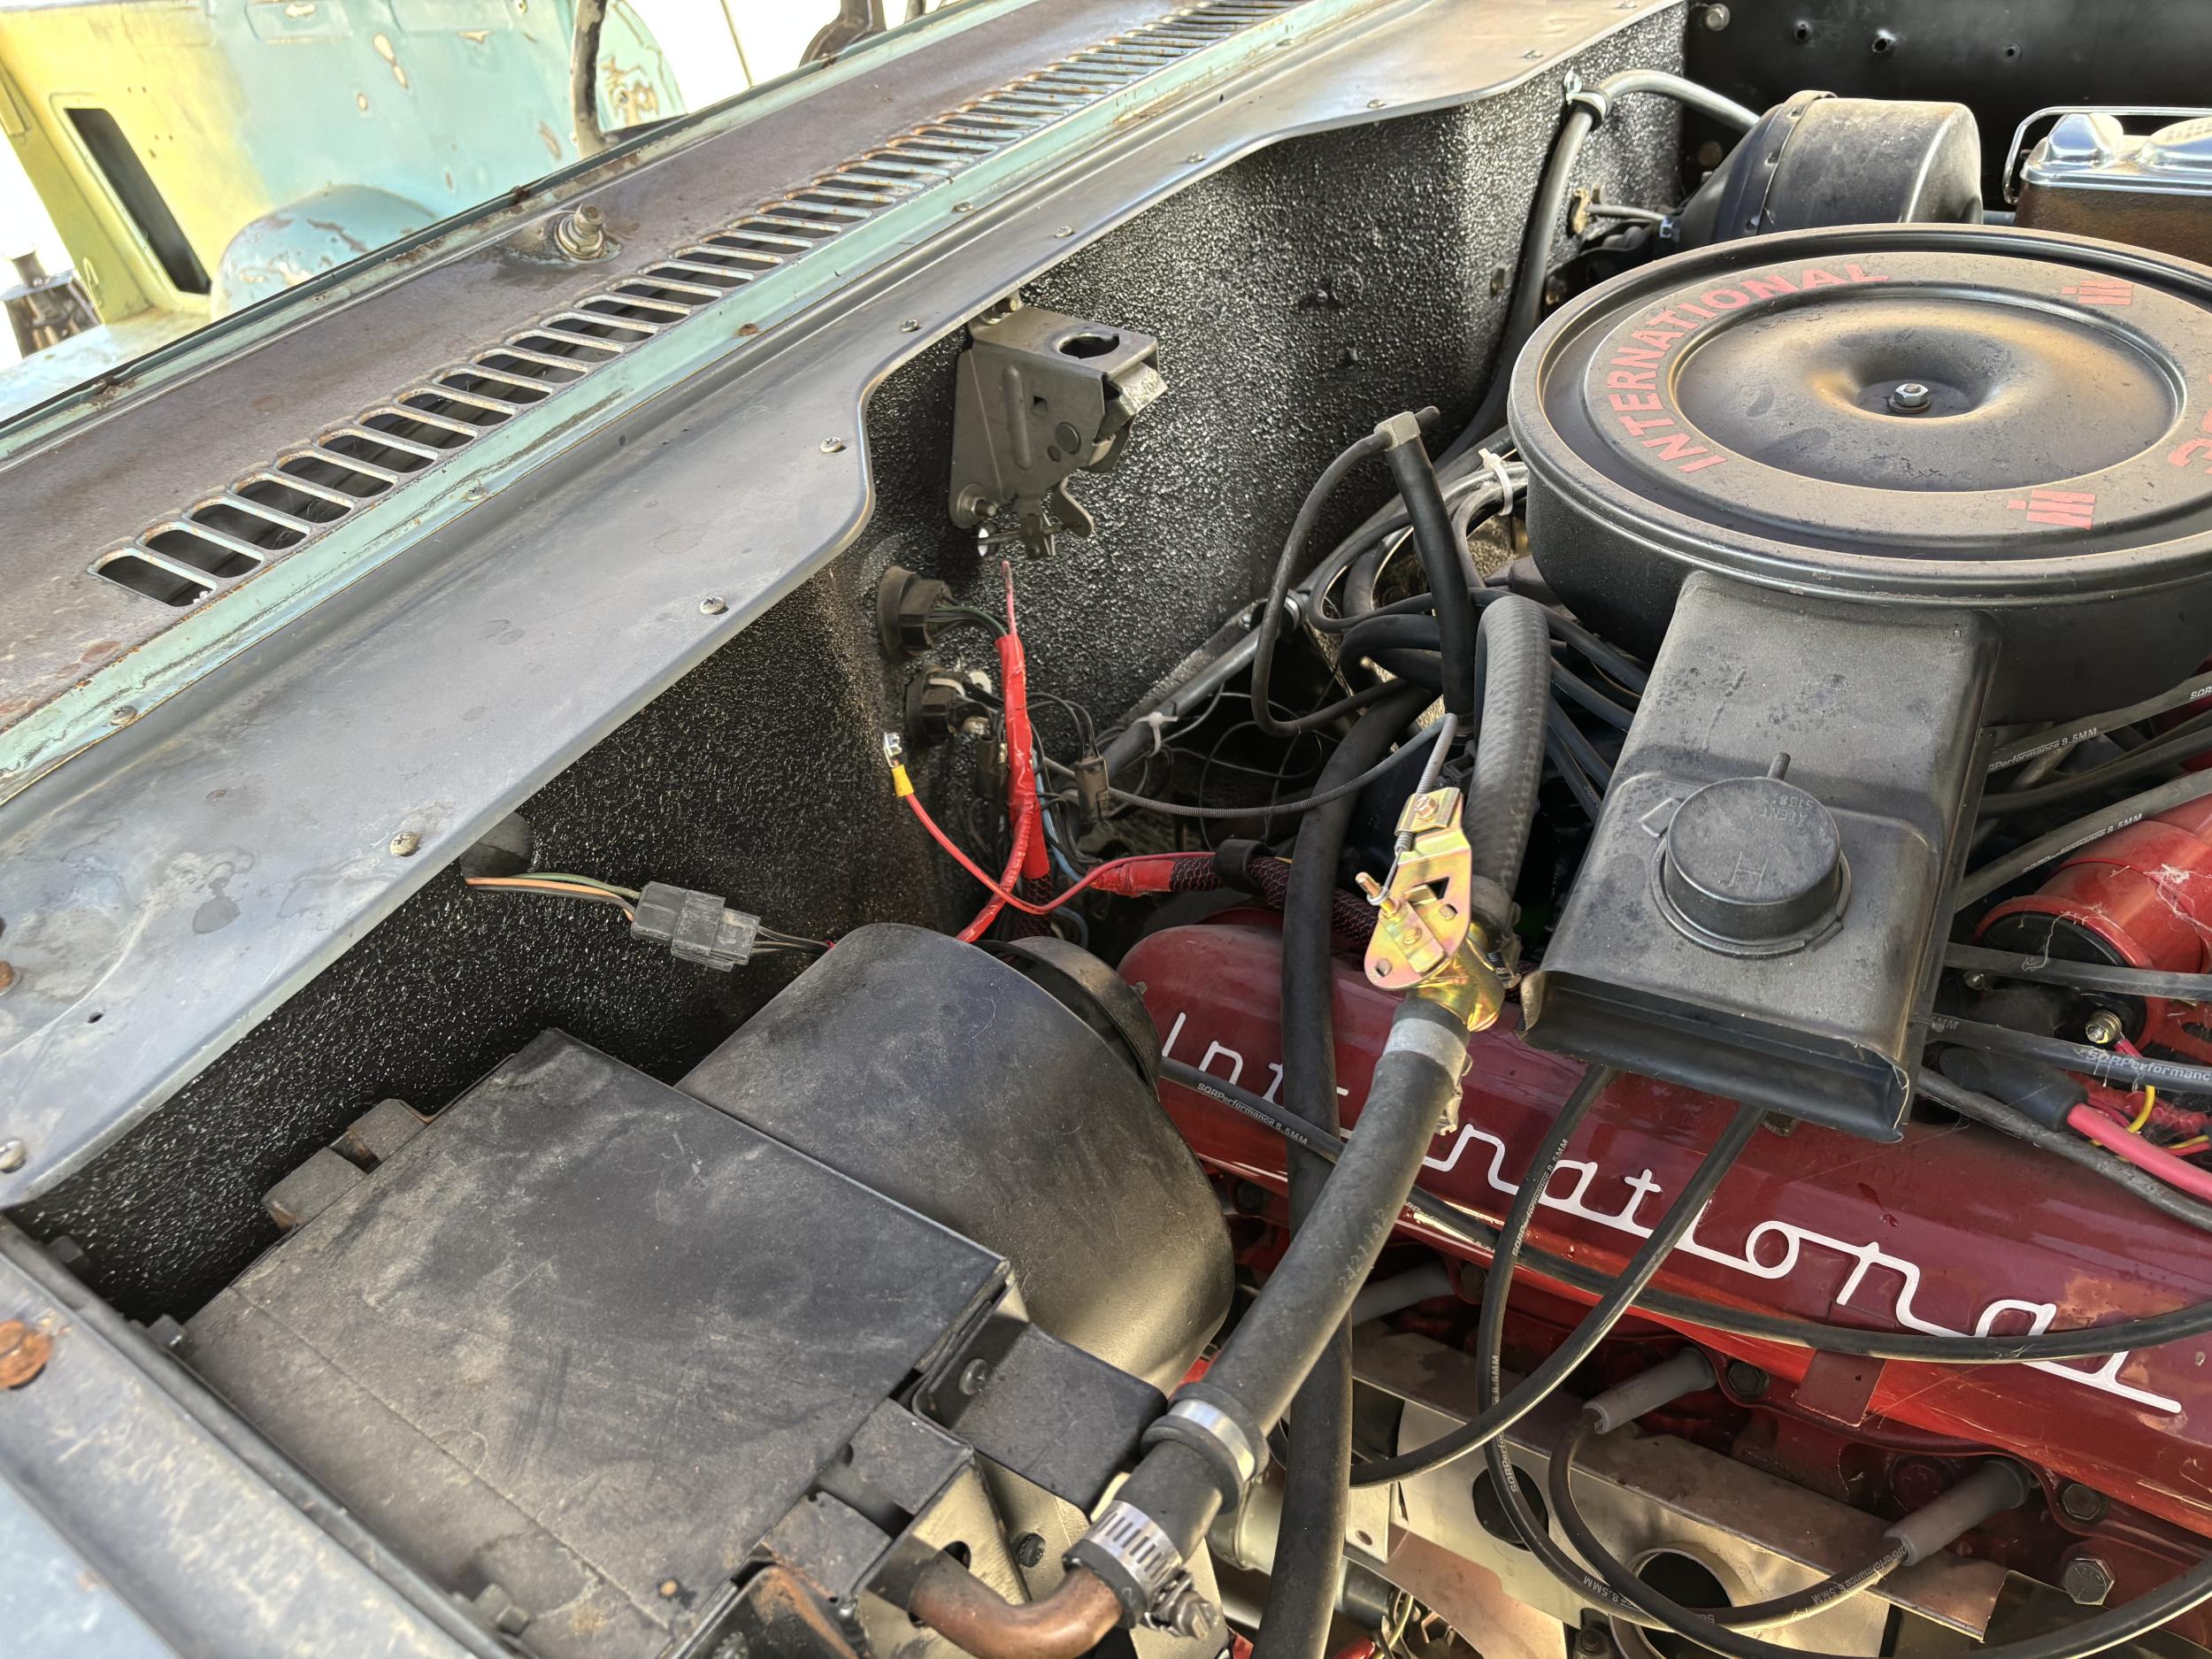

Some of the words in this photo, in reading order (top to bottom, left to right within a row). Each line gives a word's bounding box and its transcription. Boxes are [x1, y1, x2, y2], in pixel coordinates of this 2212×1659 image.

[1607, 263, 1890, 472] INTERNATIONAL
[1987, 740, 2060, 772] RPerformance
[2062, 727, 2097, 746] 8.5MM
[2086, 1049, 2212, 1081] SQRPerformanc
[1276, 1122, 1309, 1145] 8.5MM
[1547, 1139, 1569, 1171] 8.5MM
[1491, 1355, 1500, 1394] 8.5MM
[1583, 1575, 1619, 1602] 8.5MM
